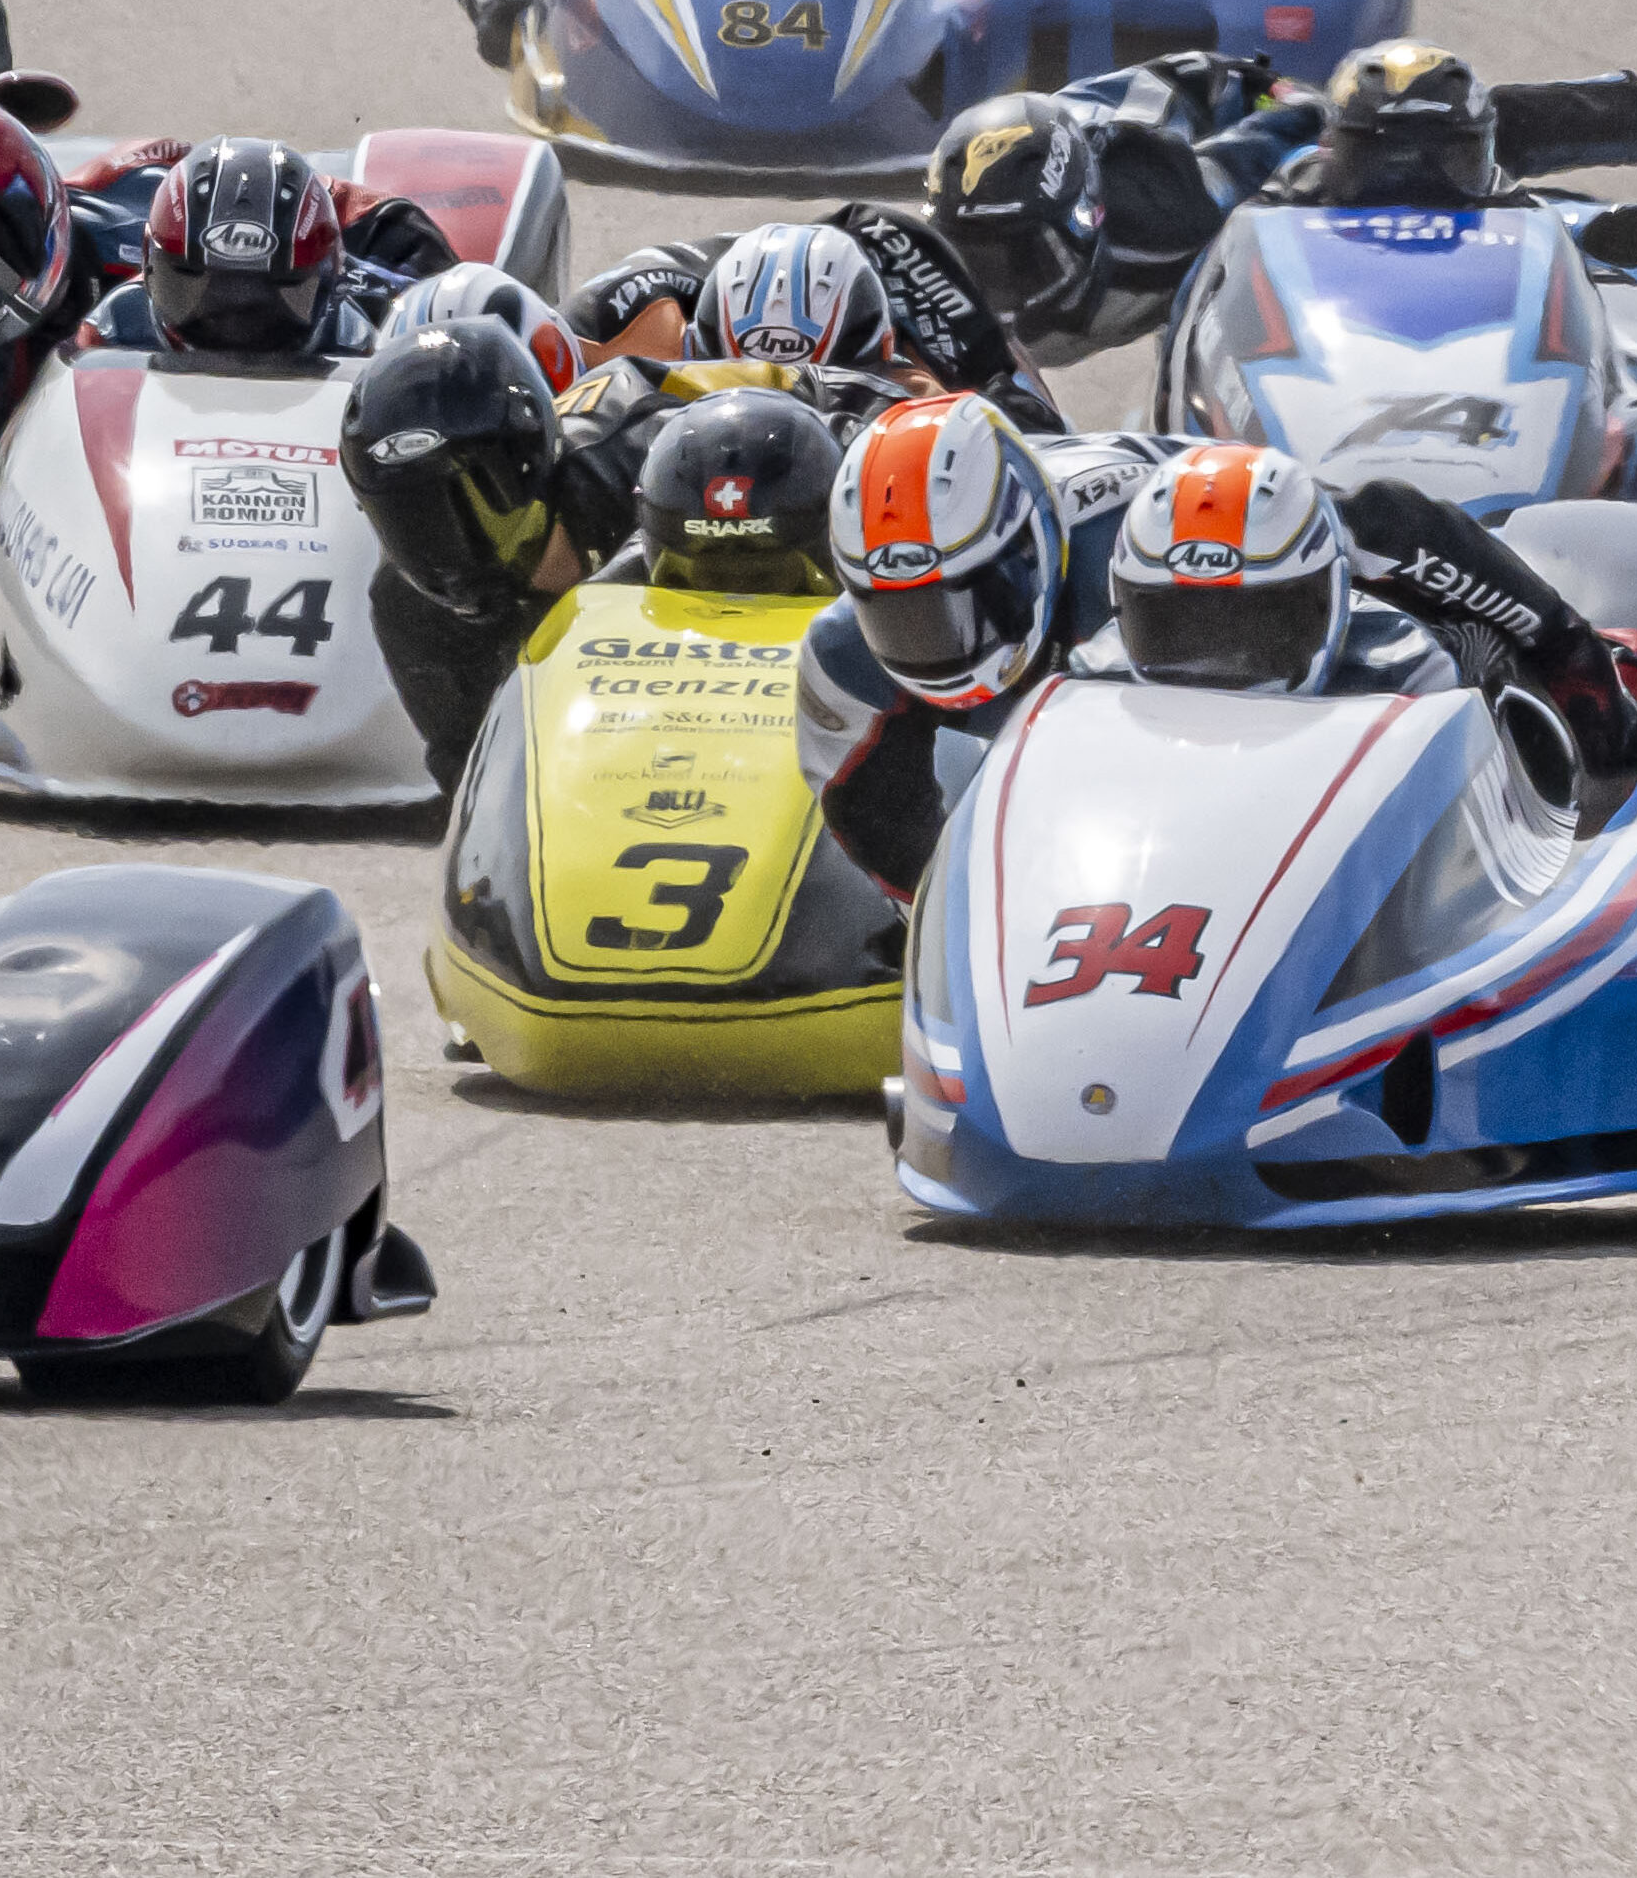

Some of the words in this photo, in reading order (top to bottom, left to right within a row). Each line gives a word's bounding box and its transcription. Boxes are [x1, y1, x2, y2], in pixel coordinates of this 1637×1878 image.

[717, 0, 831, 51] 84
[219, 225, 269, 251] Arai
[746, 329, 809, 358] Arai
[177, 441, 329, 465] MOTUL
[201, 493, 307, 509] KANNON
[684, 518, 772, 535] SHARK
[867, 544, 939, 578] Arai
[1171, 541, 1236, 571] Arai
[168, 575, 335, 657] 44
[585, 842, 750, 951] 3
[1023, 904, 1213, 1008] 34
